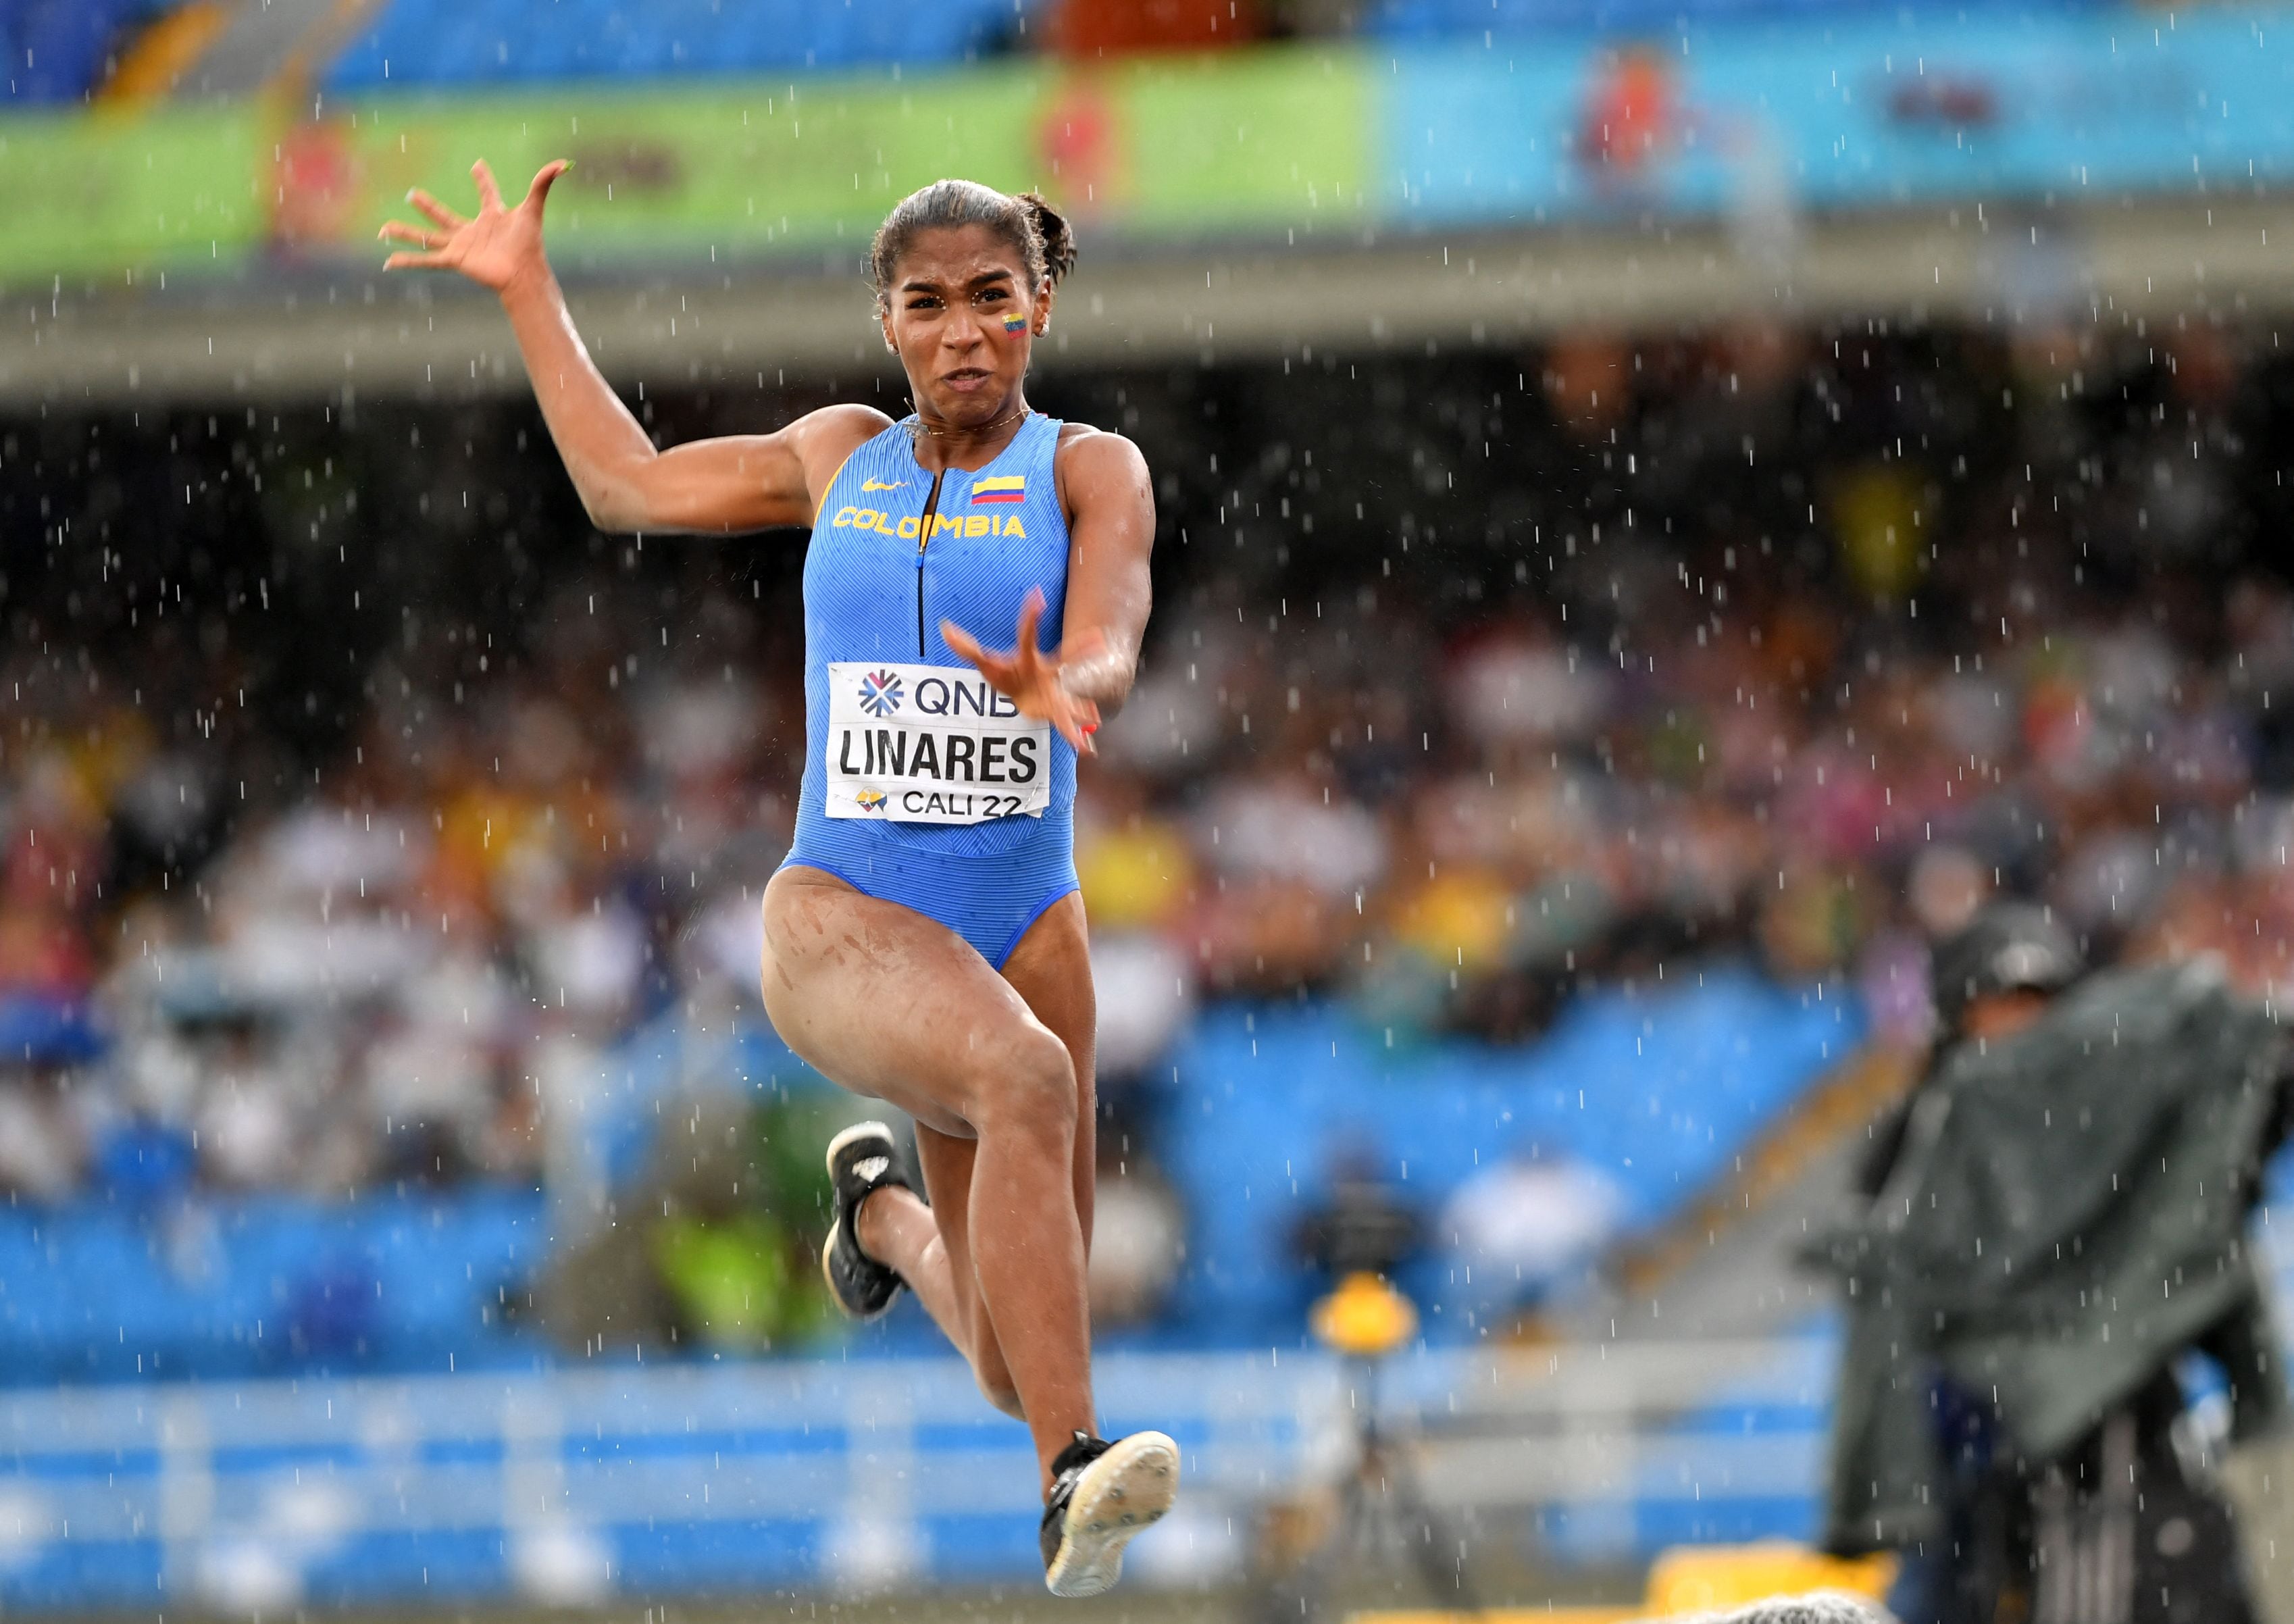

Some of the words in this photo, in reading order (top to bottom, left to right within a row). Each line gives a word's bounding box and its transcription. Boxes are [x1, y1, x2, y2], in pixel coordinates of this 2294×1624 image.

[834, 507, 1026, 538] COLOMBIA
[840, 730, 1037, 784] LINARES
[902, 790, 973, 816] CALI
[982, 795, 1021, 817] 22
